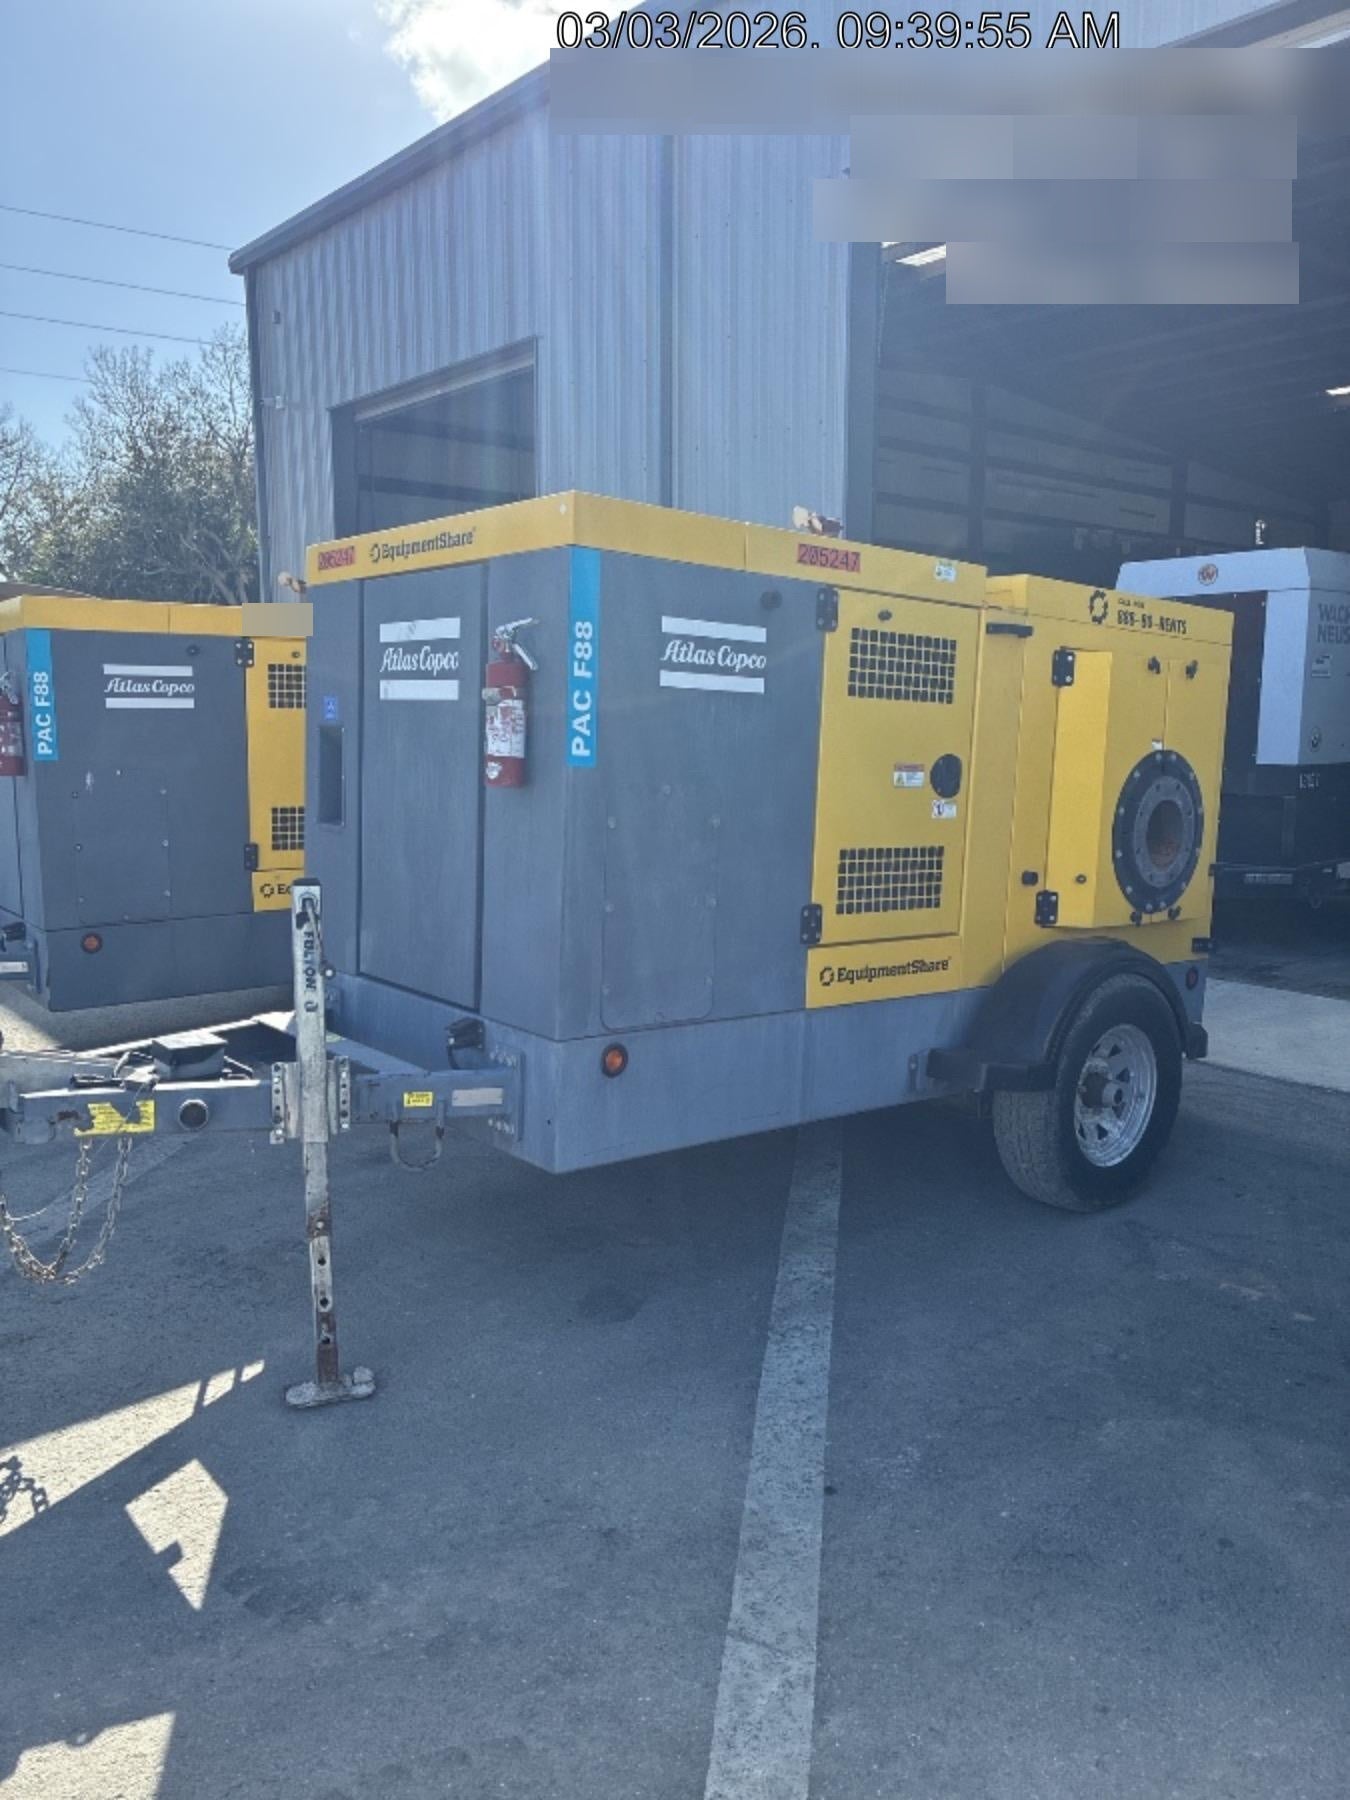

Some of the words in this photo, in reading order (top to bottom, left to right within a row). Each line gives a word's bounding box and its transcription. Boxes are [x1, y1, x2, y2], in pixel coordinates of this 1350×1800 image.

[381, 531, 473, 562] EquipmentShare
[797, 543, 860, 572] 205247
[379, 646, 419, 673] Atlas
[419, 645, 459, 677] Copco
[573, 621, 593, 679] F88
[660, 639, 716, 665] Atlas
[717, 645, 767, 673] Copco
[33, 671, 50, 707] F88
[104, 677, 150, 694] Atlas
[151, 680, 195, 697] Copco
[35, 713, 53, 755] PAC
[571, 689, 592, 757] PAC
[837, 958, 949, 985] EquipmentShare
